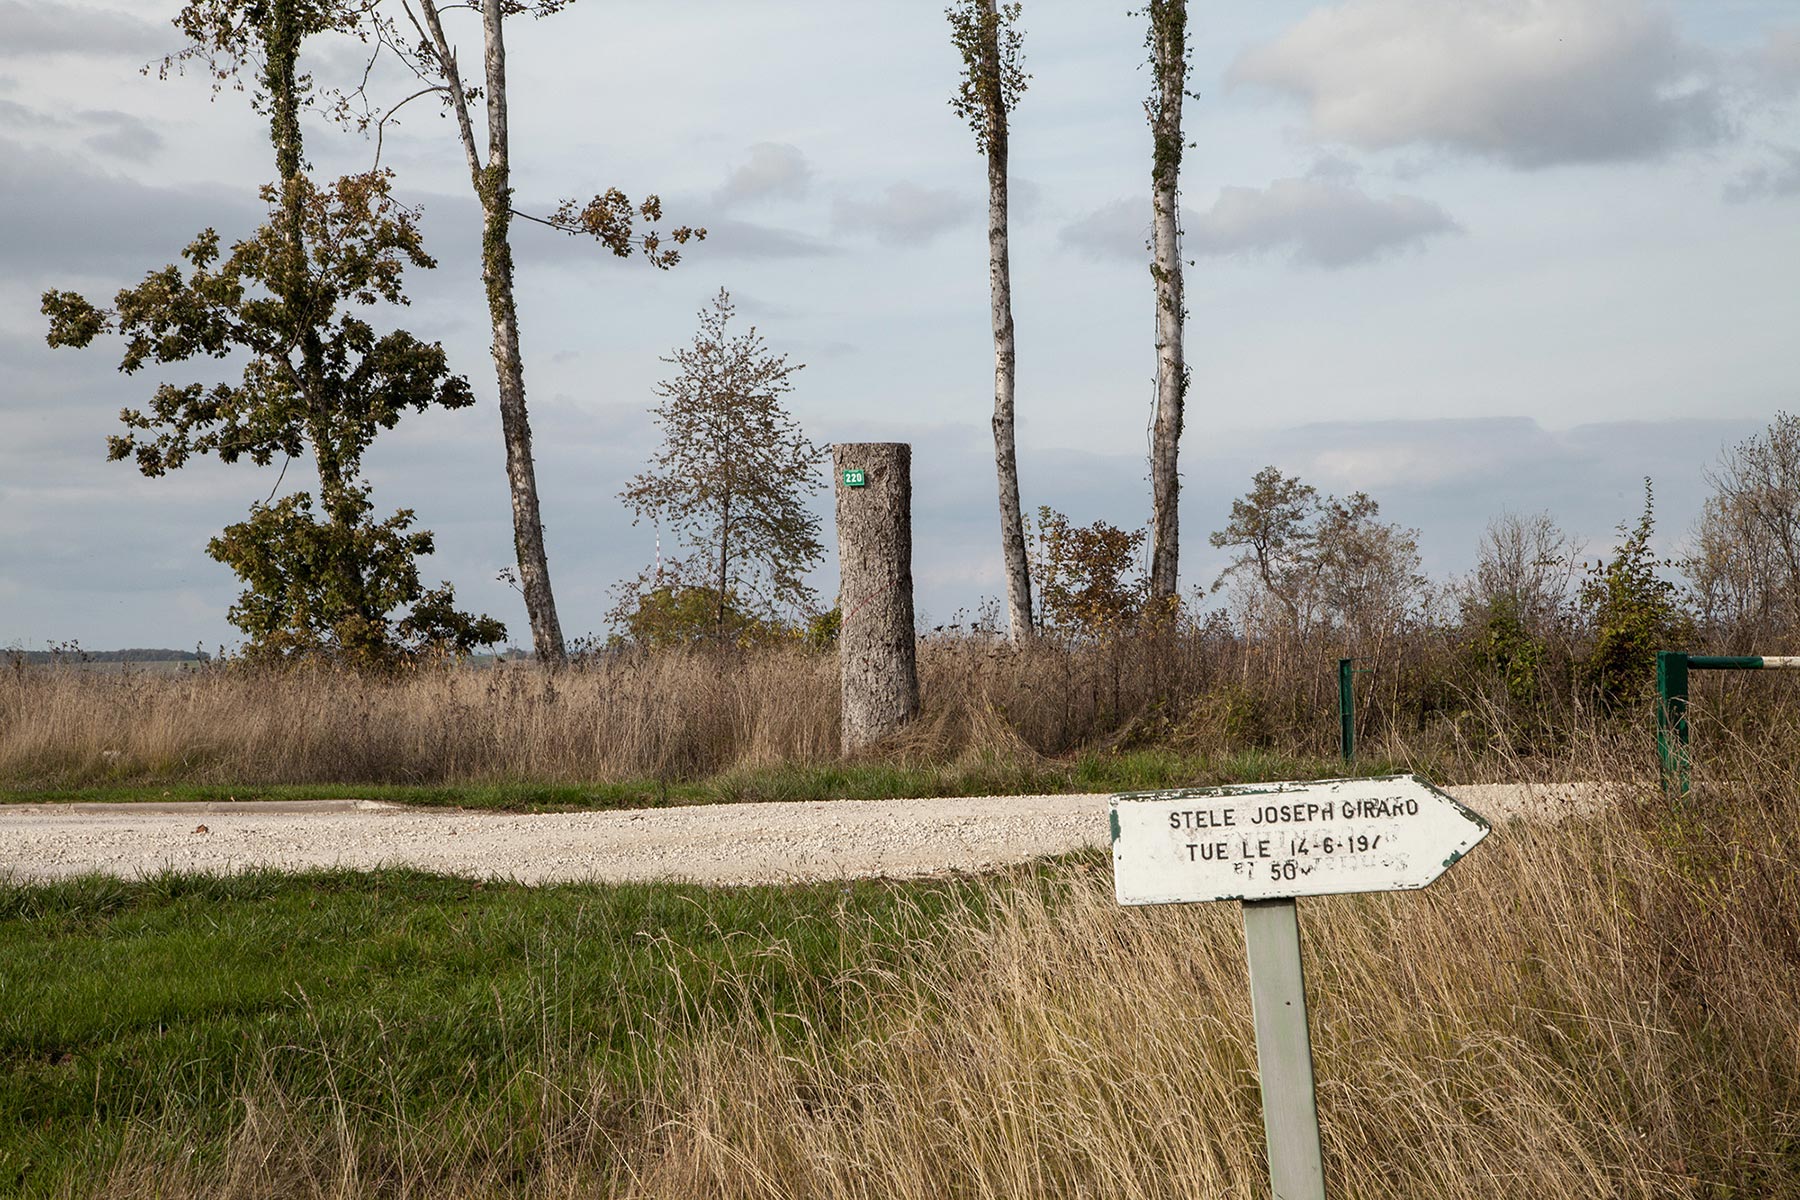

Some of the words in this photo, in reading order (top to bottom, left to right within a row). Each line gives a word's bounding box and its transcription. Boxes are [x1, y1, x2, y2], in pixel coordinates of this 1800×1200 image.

[845, 473, 862, 483] 220
[1170, 809, 1236, 829] STELE
[1251, 803, 1334, 825] JOSEPH
[1342, 799, 1418, 820] GIRARD
[1186, 843, 1229, 862] TUE
[1243, 840, 1271, 858] LE
